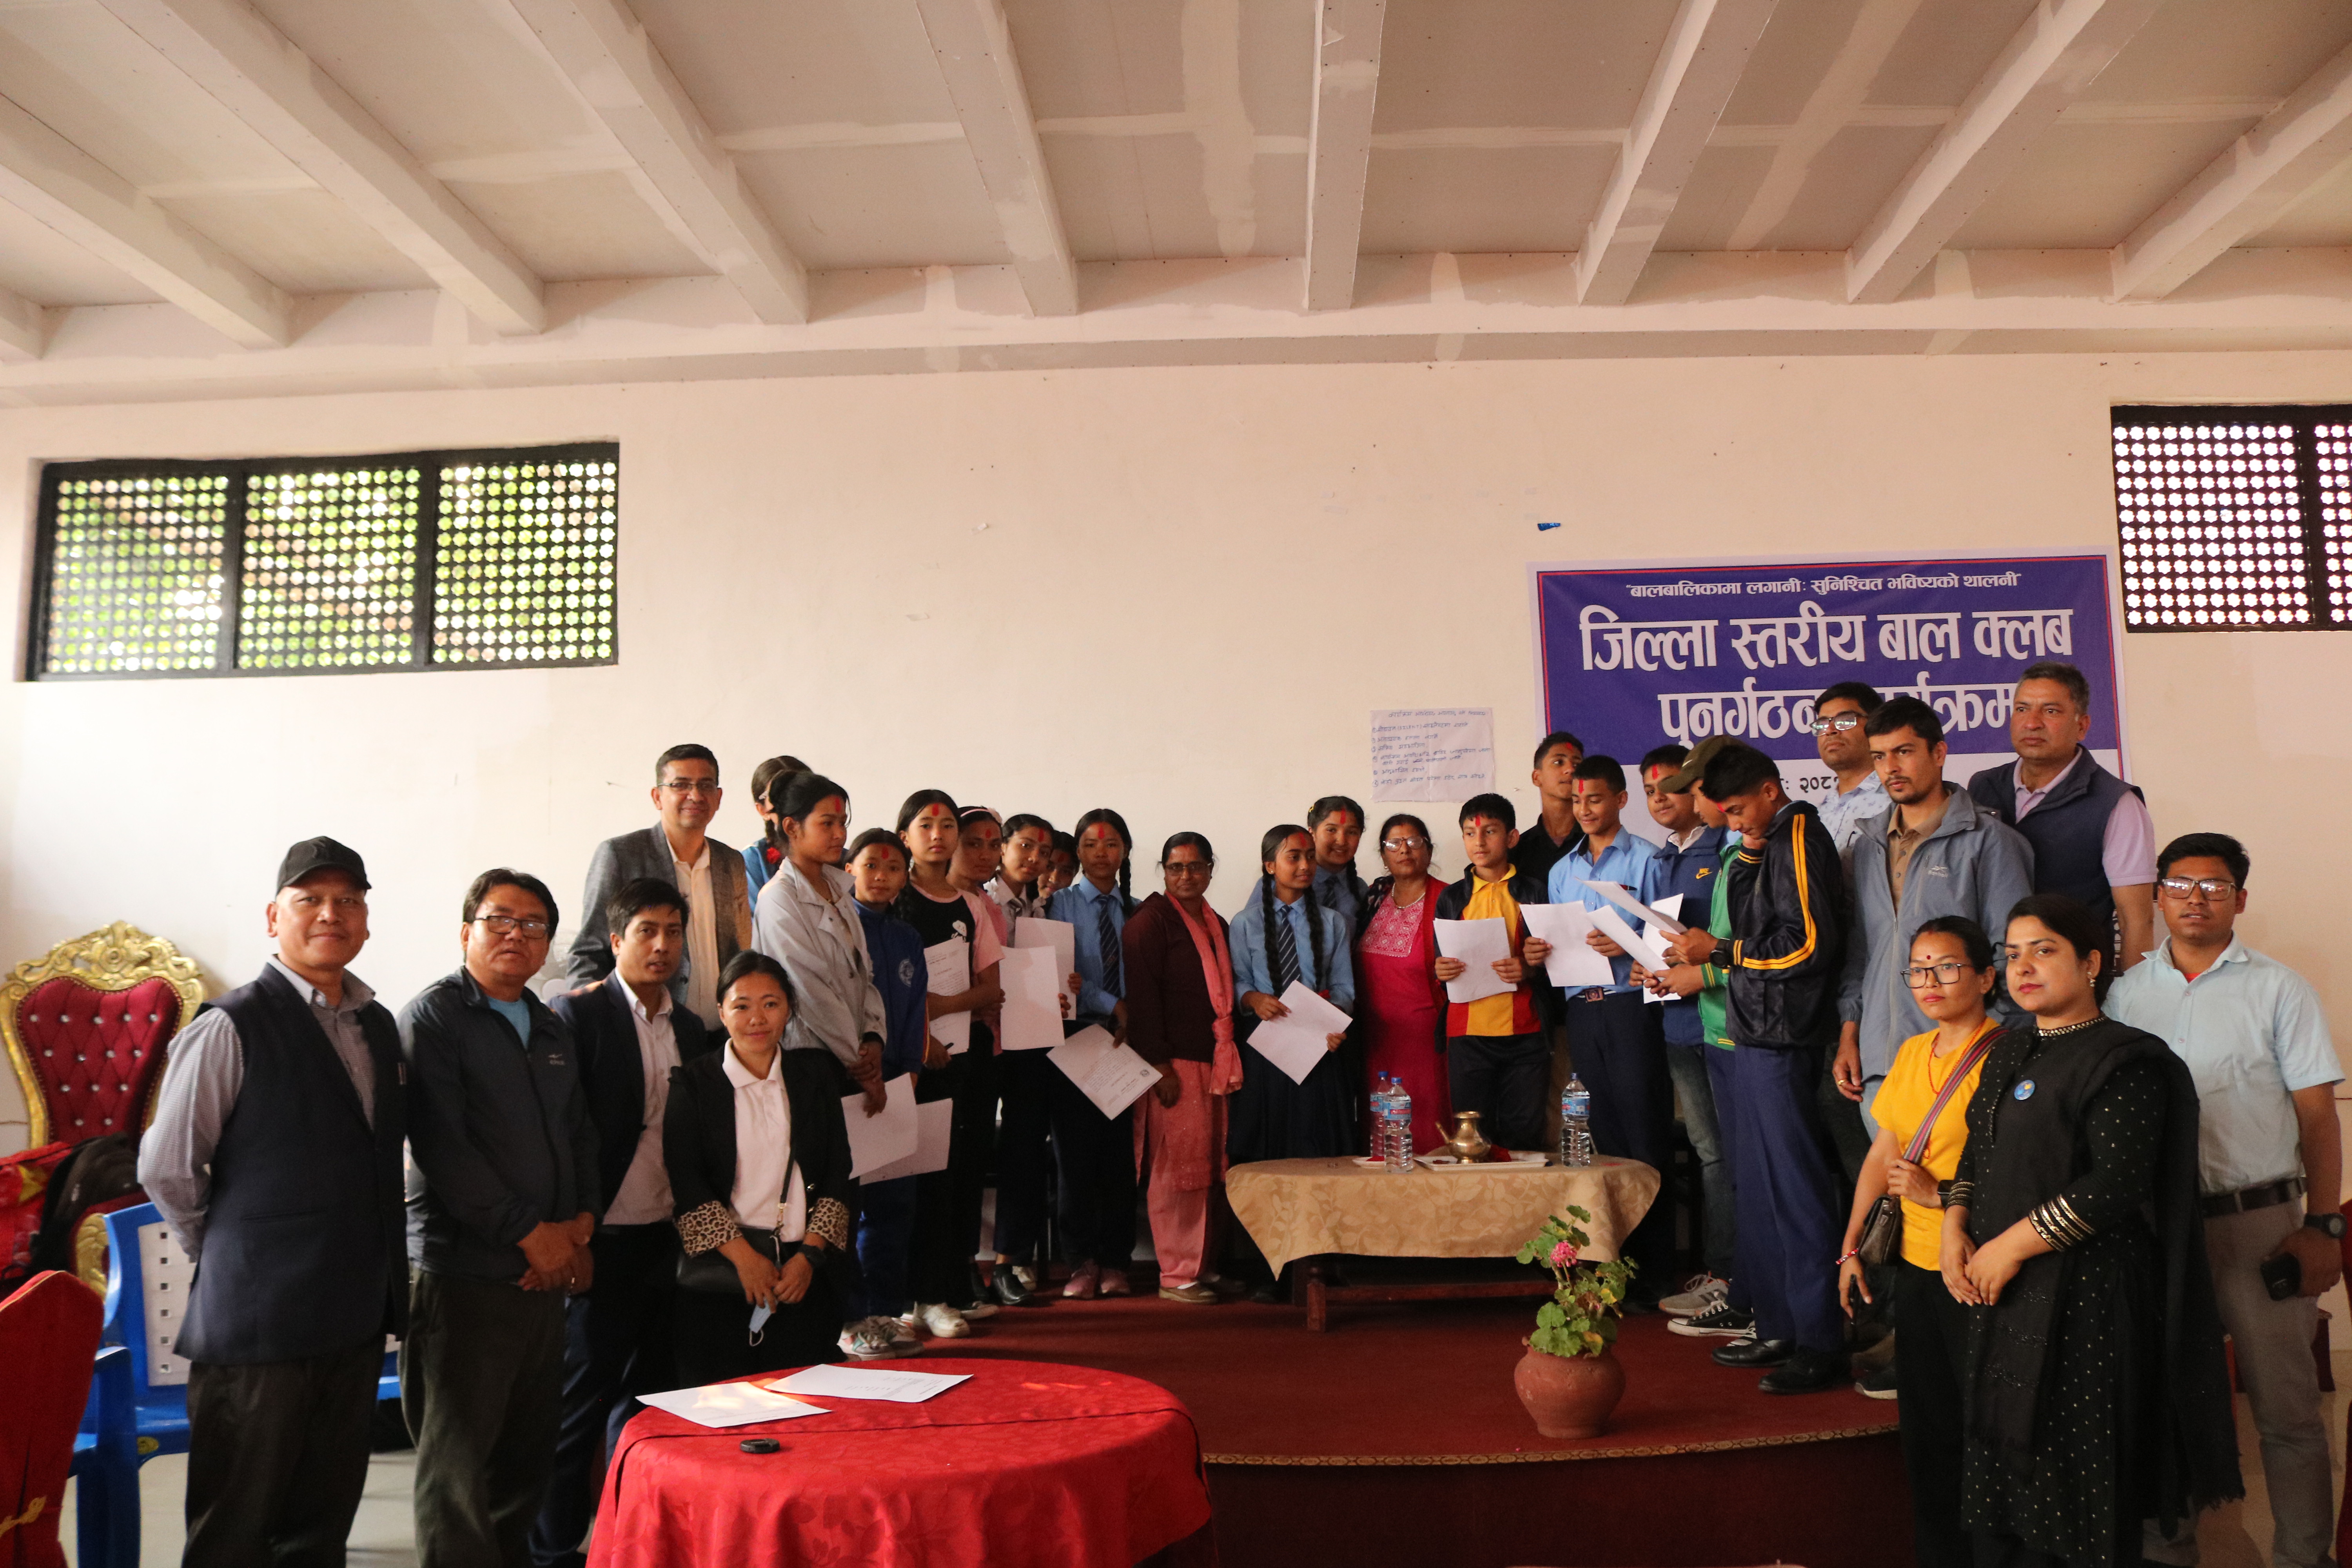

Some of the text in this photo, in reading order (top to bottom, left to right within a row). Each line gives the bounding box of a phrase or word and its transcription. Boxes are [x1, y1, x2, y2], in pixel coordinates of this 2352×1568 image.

[1810, 575, 1883, 595] सुनिश्चित
[1887, 572, 1959, 590] भविष्यको
[1579, 601, 2074, 671] जिल्ला स्तरीय बाल क्लब
